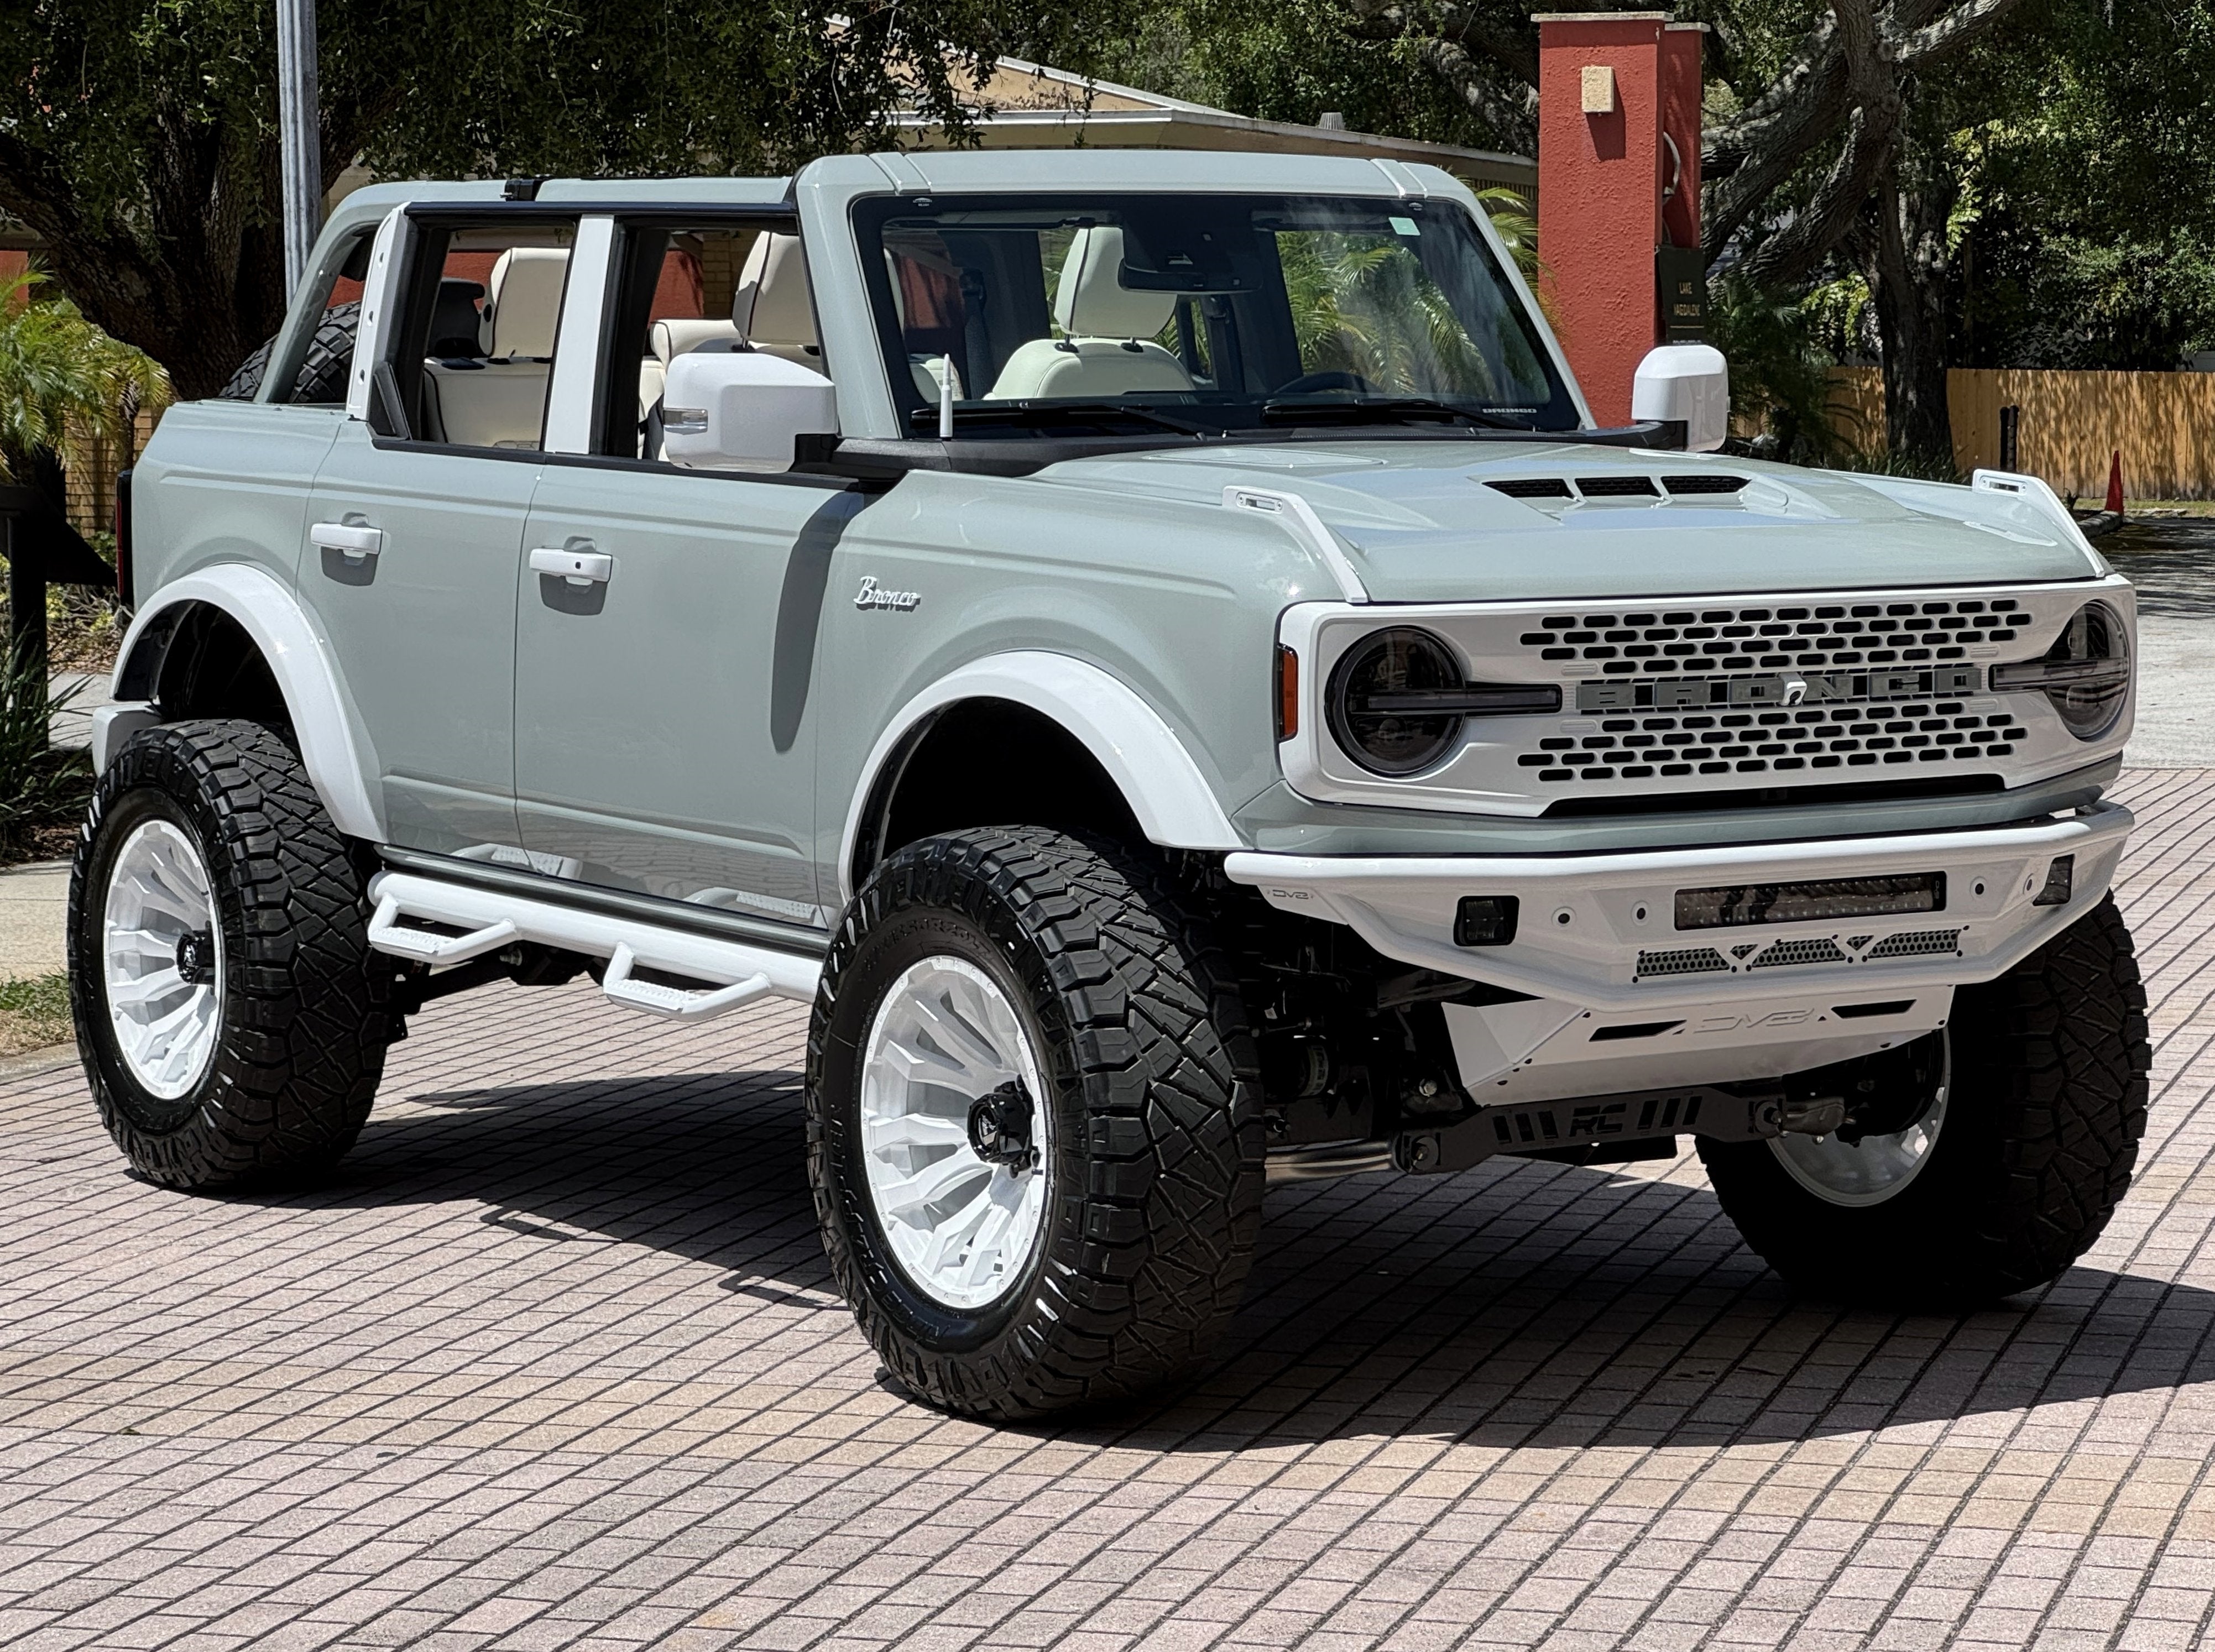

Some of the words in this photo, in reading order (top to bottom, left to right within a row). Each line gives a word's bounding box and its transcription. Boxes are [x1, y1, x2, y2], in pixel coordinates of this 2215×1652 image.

[853, 576, 921, 607] Bronco
[1577, 667, 1982, 709] BRONCO
[1570, 1103, 1627, 1137] RC
